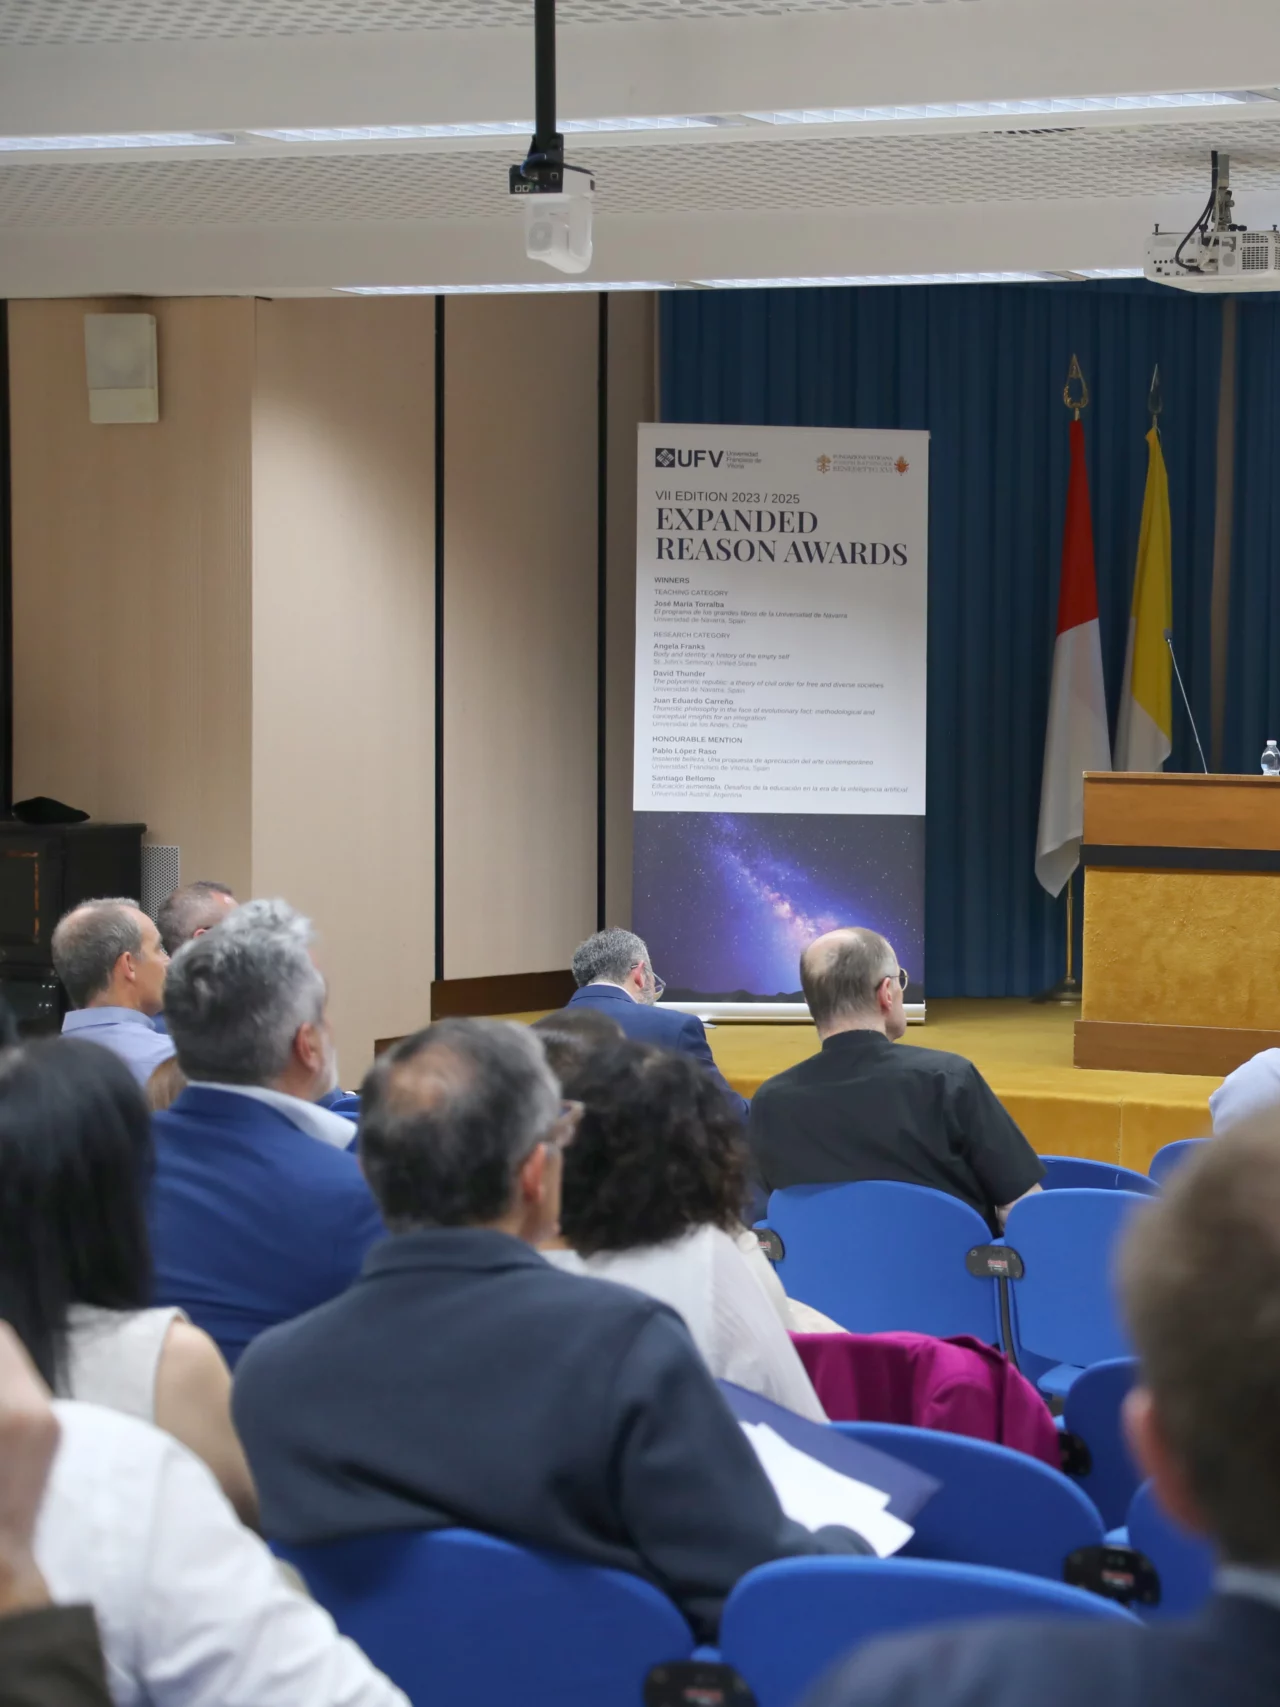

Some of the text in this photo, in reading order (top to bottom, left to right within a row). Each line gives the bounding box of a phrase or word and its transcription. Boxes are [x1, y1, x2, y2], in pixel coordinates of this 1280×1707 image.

[677, 449, 724, 468] UFV
[655, 490, 800, 504] VII EDITION 2023 / 2025
[655, 508, 818, 534] EXPANDED
[655, 537, 907, 566] REASON AWARDS
[654, 643, 679, 652] Angela
[707, 736, 743, 744] MENTION
[674, 748, 696, 756] López
[652, 775, 683, 783] Santiago
